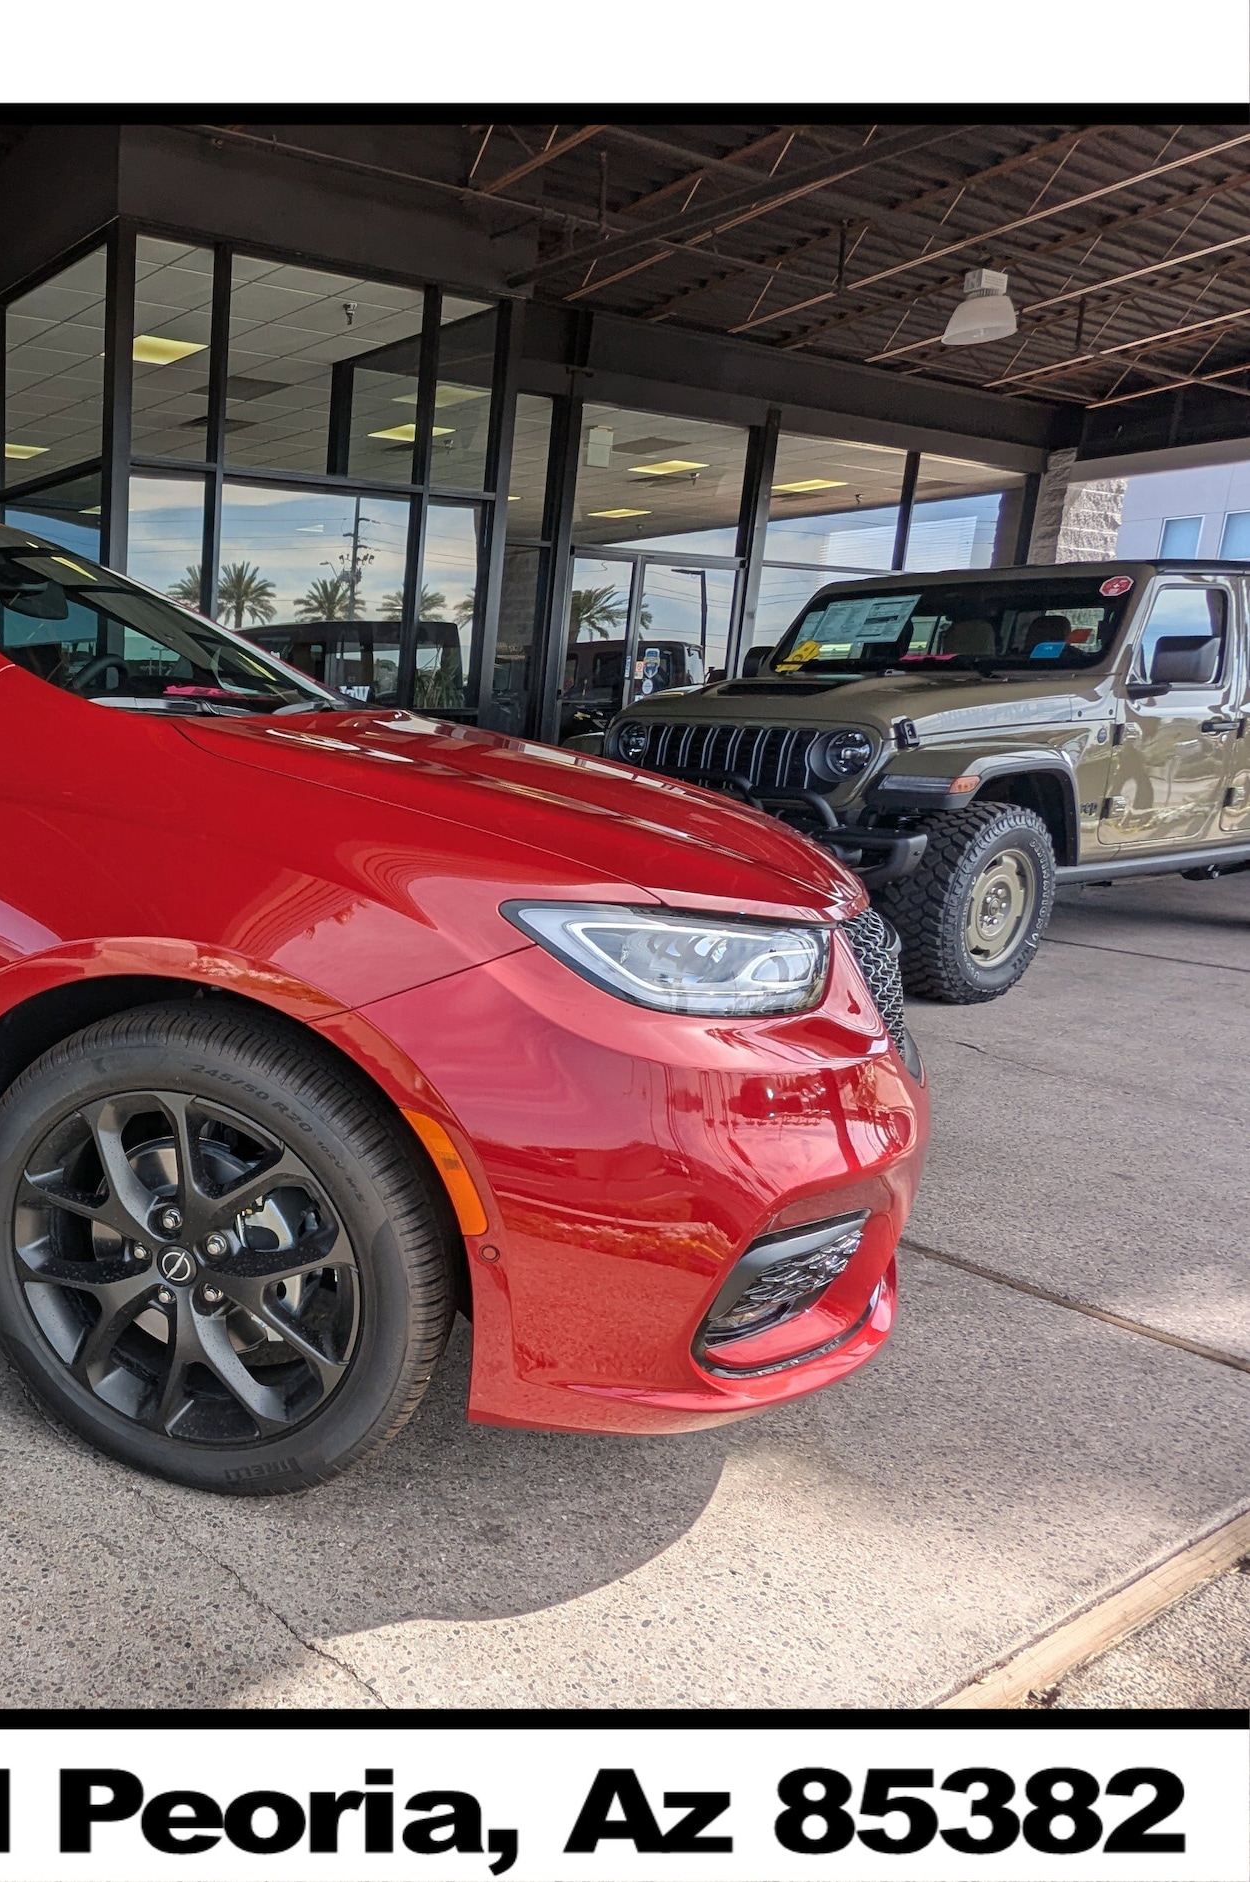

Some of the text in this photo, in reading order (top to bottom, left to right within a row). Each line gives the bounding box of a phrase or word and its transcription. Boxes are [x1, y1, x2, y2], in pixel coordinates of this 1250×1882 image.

[1029, 837, 1051, 930] DESTINATION
[191, 1063, 270, 1101] 245/50
[271, 1101, 313, 1133] R20
[224, 1456, 304, 1480] PIRELLI
